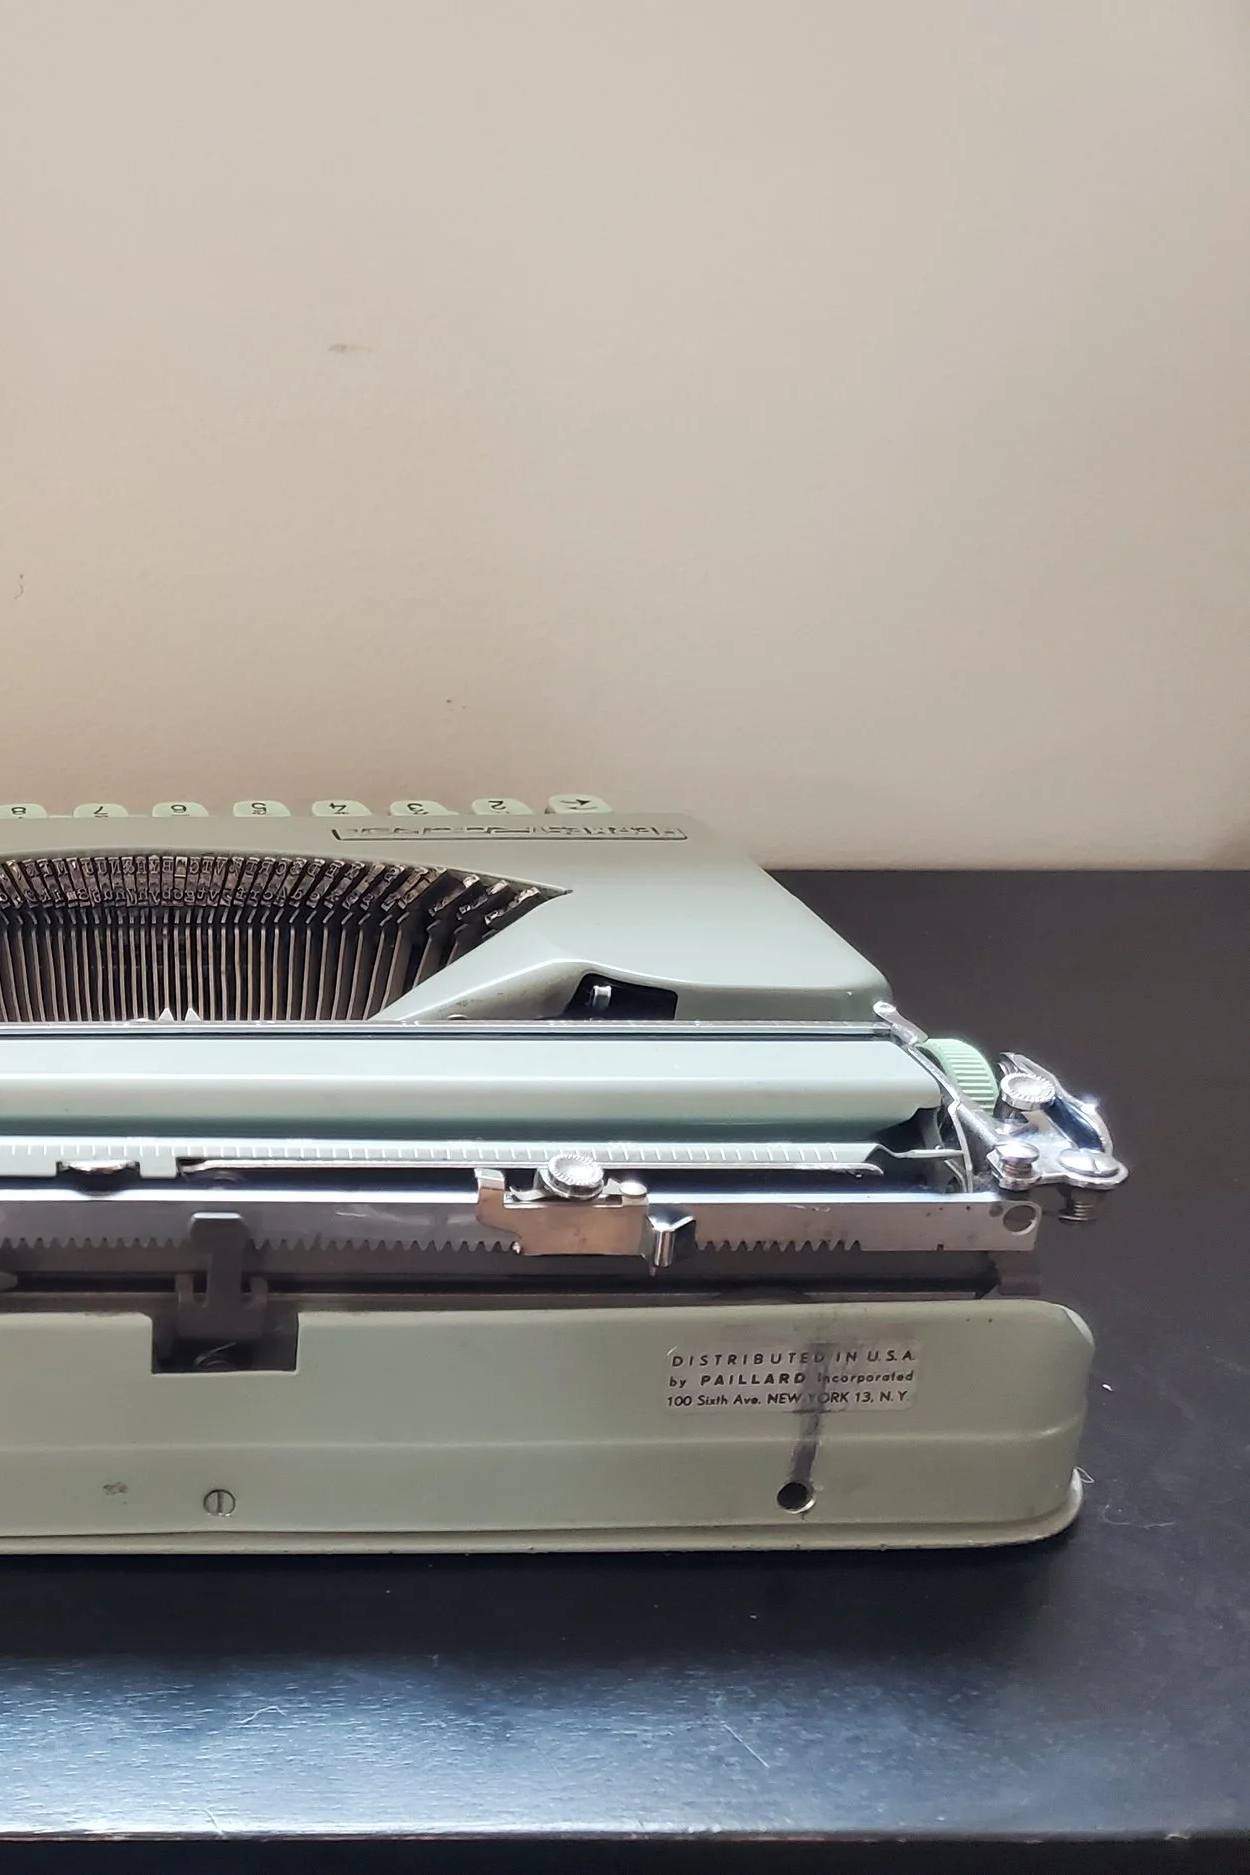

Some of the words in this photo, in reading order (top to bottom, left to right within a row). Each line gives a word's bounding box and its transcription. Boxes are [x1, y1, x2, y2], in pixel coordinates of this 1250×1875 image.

[672, 1352, 825, 1367] DISTRIBUTED
[835, 1351, 857, 1363] IN
[669, 1376, 687, 1388] by
[700, 1372, 806, 1386] PAILLARD
[667, 1395, 692, 1407] 100
[697, 1394, 728, 1406] Sixth
[733, 1394, 761, 1405] Ave.
[767, 1392, 803, 1404] NEW
[808, 1391, 850, 1404] YORK
